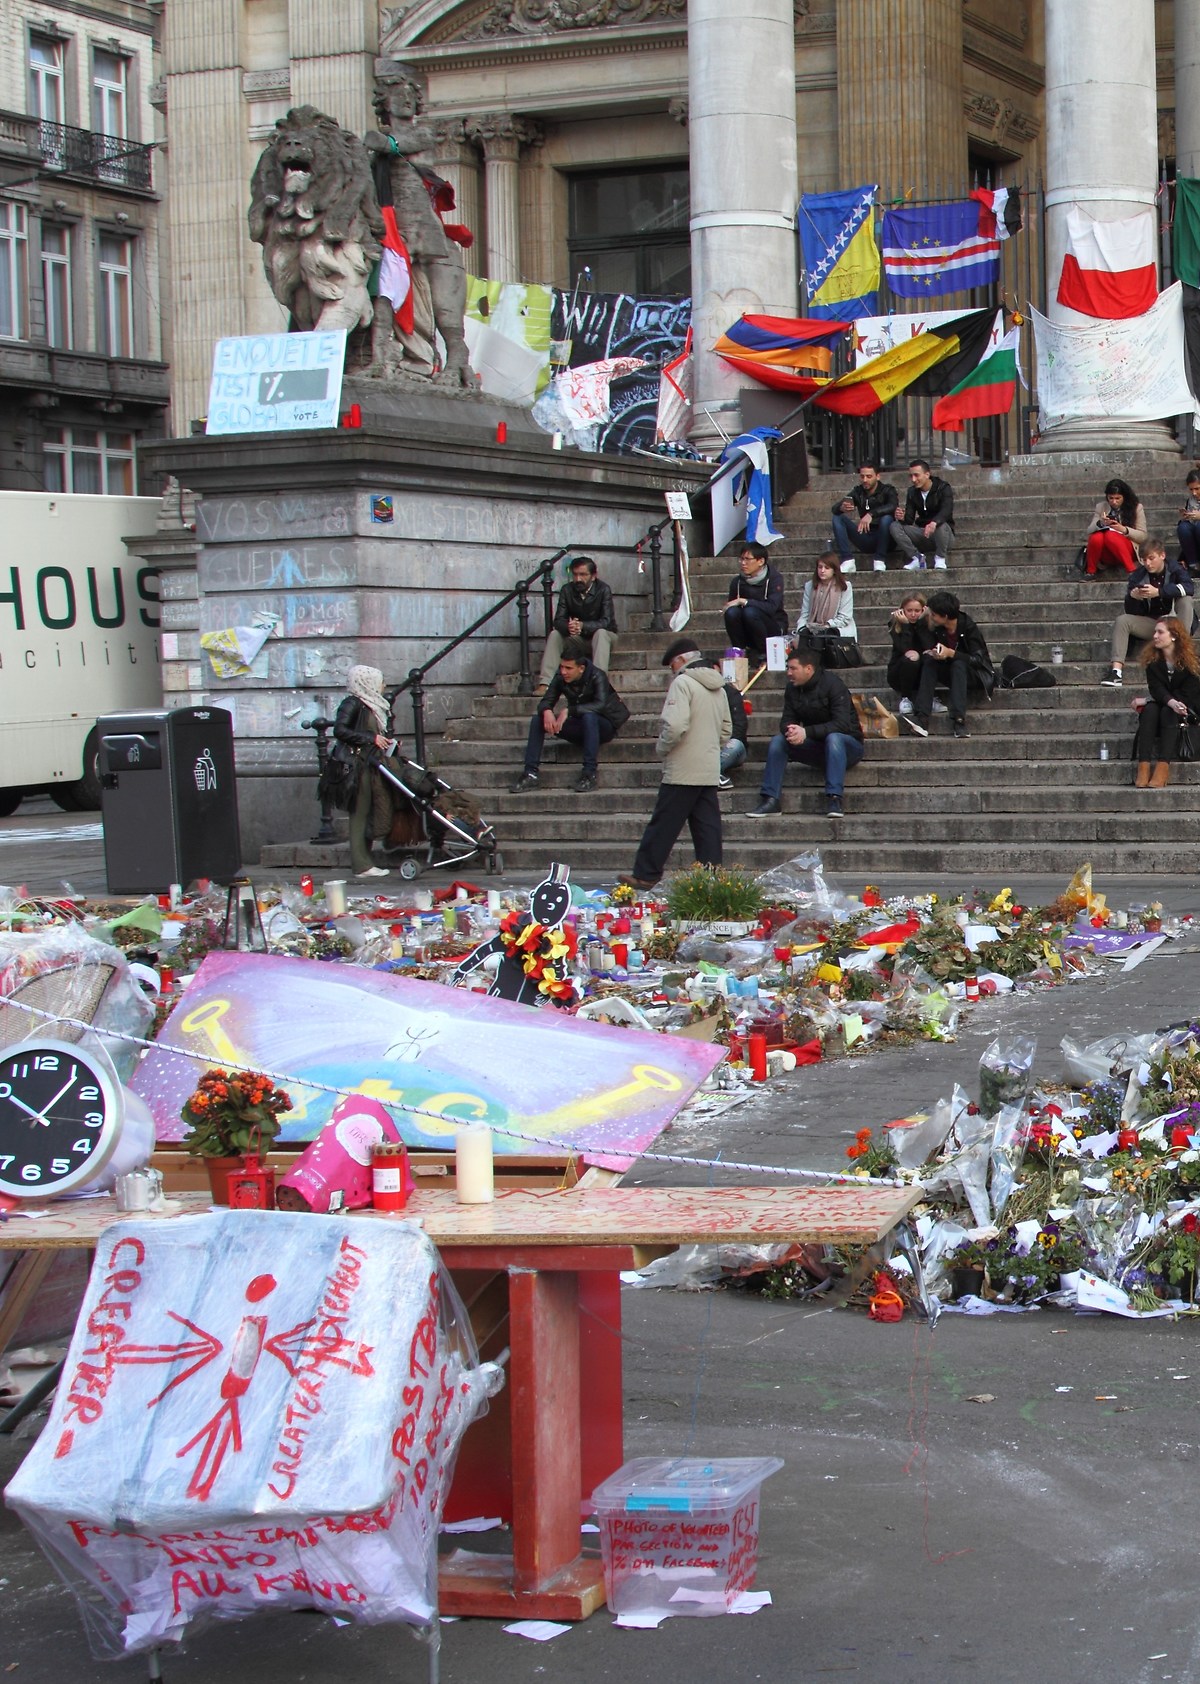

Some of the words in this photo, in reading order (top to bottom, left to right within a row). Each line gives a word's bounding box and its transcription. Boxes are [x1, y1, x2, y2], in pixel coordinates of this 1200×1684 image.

[213, 371, 257, 396] TEST
[293, 412, 319, 420] VOTE
[1012, 455, 1039, 466] VIVE
[12, 1063, 28, 1078] 11
[34, 1055, 59, 1071] 12
[79, 1086, 99, 1101] 2
[84, 1112, 103, 1128] 3
[72, 1138, 91, 1154] 4
[21, 1164, 42, 1181] 6
[51, 1158, 70, 1174] 5
[614, 1519, 658, 1535] PHOTO
[661, 1522, 676, 1534] OF
[163, 1544, 277, 1570] INFO
